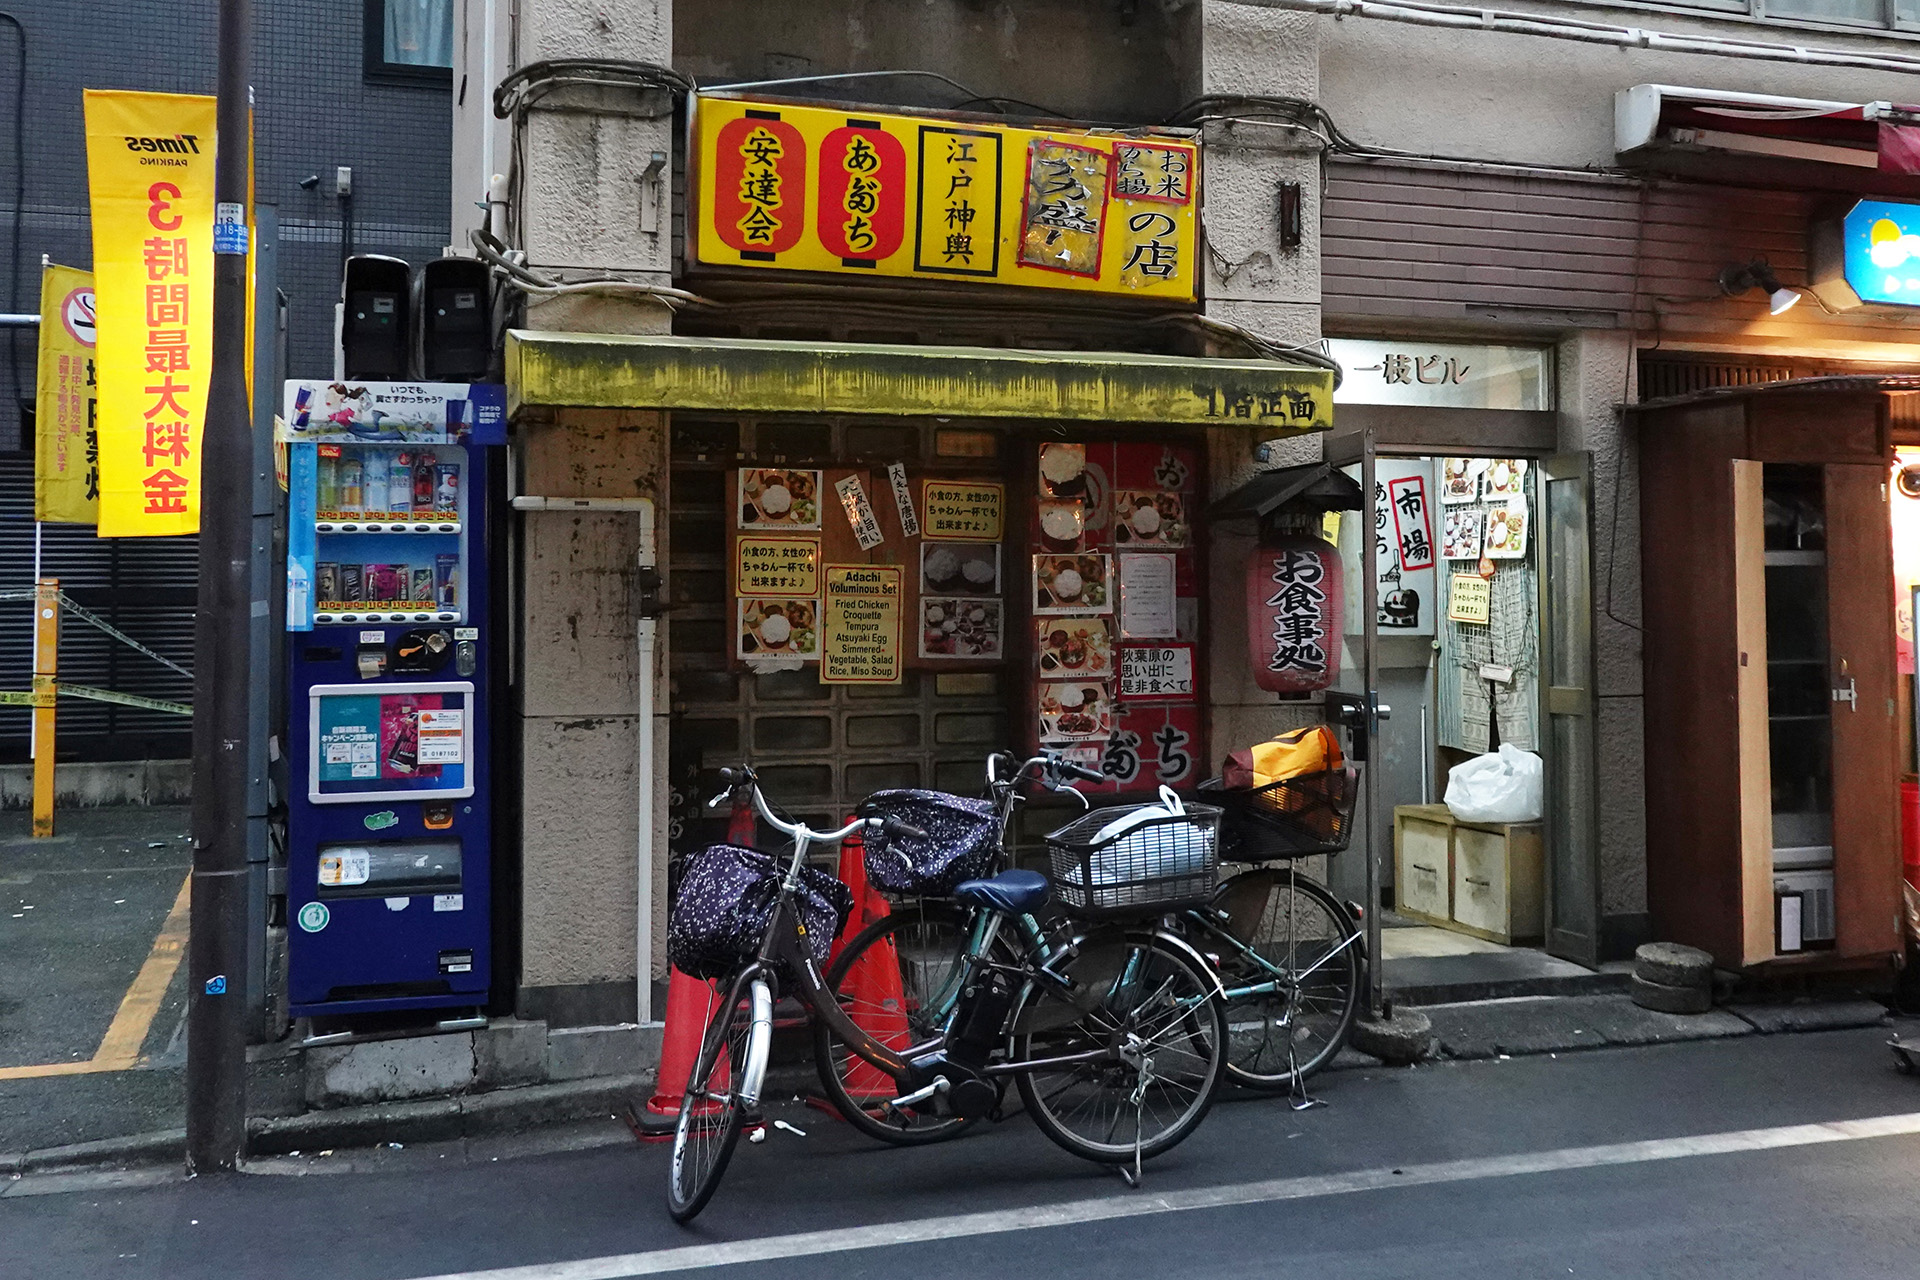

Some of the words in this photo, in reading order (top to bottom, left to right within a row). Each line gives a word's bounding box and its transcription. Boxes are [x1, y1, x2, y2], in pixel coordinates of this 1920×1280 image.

[1156, 150, 1187, 198] お米
[741, 131, 782, 246] 安達会
[942, 138, 977, 266] 江戸神輿
[1121, 211, 1177, 277] の店
[1353, 353, 1471, 385] 一枝ビル
[892, 467, 917, 535] 大きな唐揚
[1396, 488, 1431, 561] 市場
[742, 546, 815, 558] 小食の方、女性の方
[742, 561, 815, 573] ちゃわん一杯でも
[845, 571, 881, 582] Adachi
[829, 583, 880, 594] Voluminous
[882, 584, 897, 594] Set
[835, 600, 856, 609] Fried
[858, 600, 890, 609] Chicken
[843, 610, 882, 620] Croquette
[1267, 552, 1325, 672] お食事処
[845, 621, 879, 632] Tempura
[836, 633, 870, 644] Atsuyaki
[872, 634, 888, 645] Egg
[842, 644, 881, 653] Simmered
[829, 655, 869, 665] Vegetable,
[871, 655, 893, 664] Salad
[1122, 649, 1175, 663] 秋葉原の
[829, 666, 849, 676] Rice,
[851, 666, 869, 675] Miso
[871, 667, 892, 677] Soup
[1121, 664, 1174, 678] 思い出に
[1121, 679, 1192, 693] 是非食べて!
[804, 957, 821, 991] Panasonic
